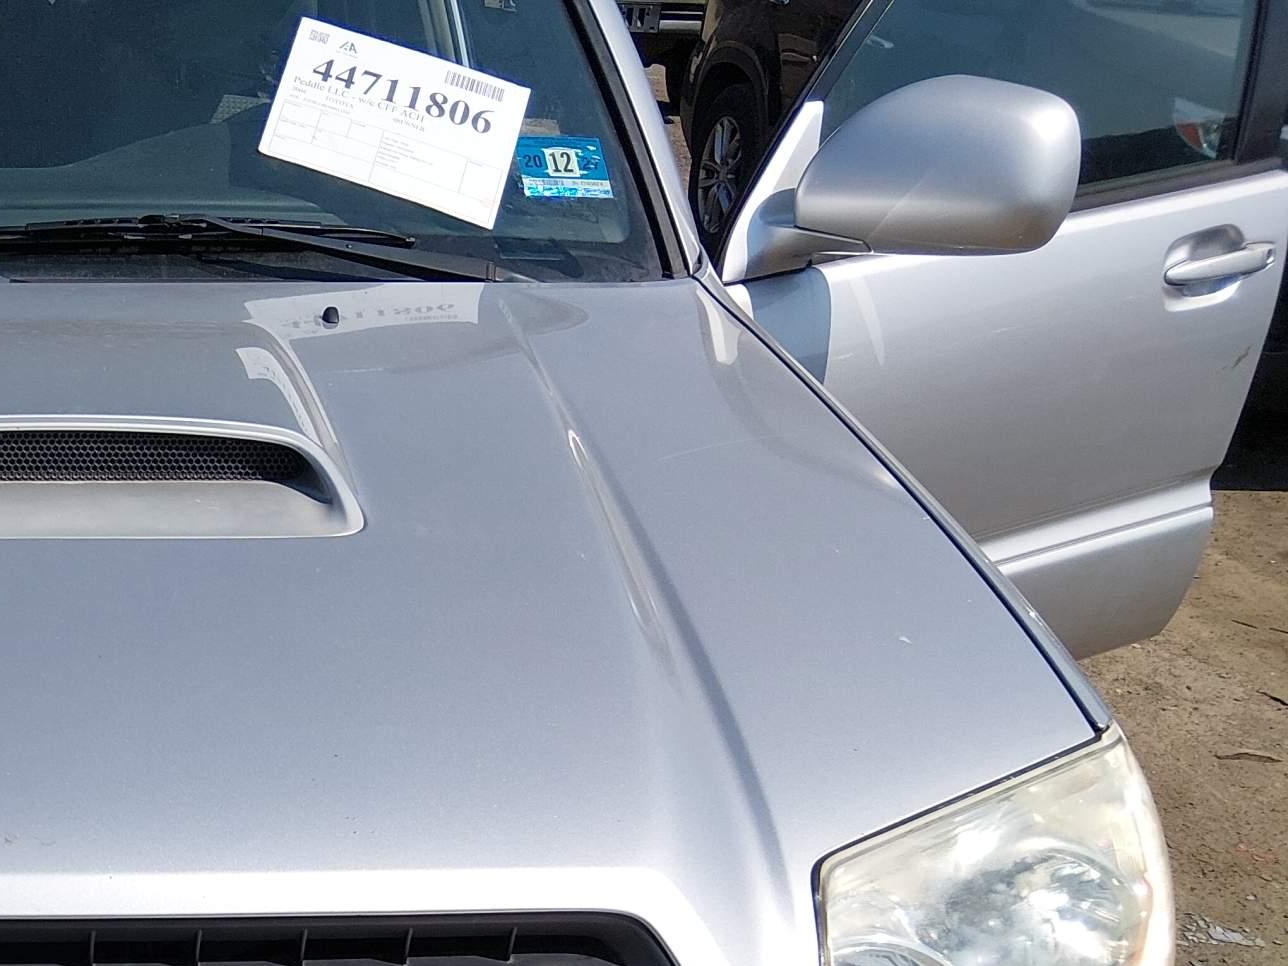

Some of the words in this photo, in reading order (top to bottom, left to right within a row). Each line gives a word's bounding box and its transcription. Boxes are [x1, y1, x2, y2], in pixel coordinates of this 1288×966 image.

[293, 75, 325, 91] Peddle
[327, 87, 350, 99] LLC
[312, 59, 496, 134] 44711806
[522, 154, 543, 169] 20
[548, 151, 574, 173] 12
